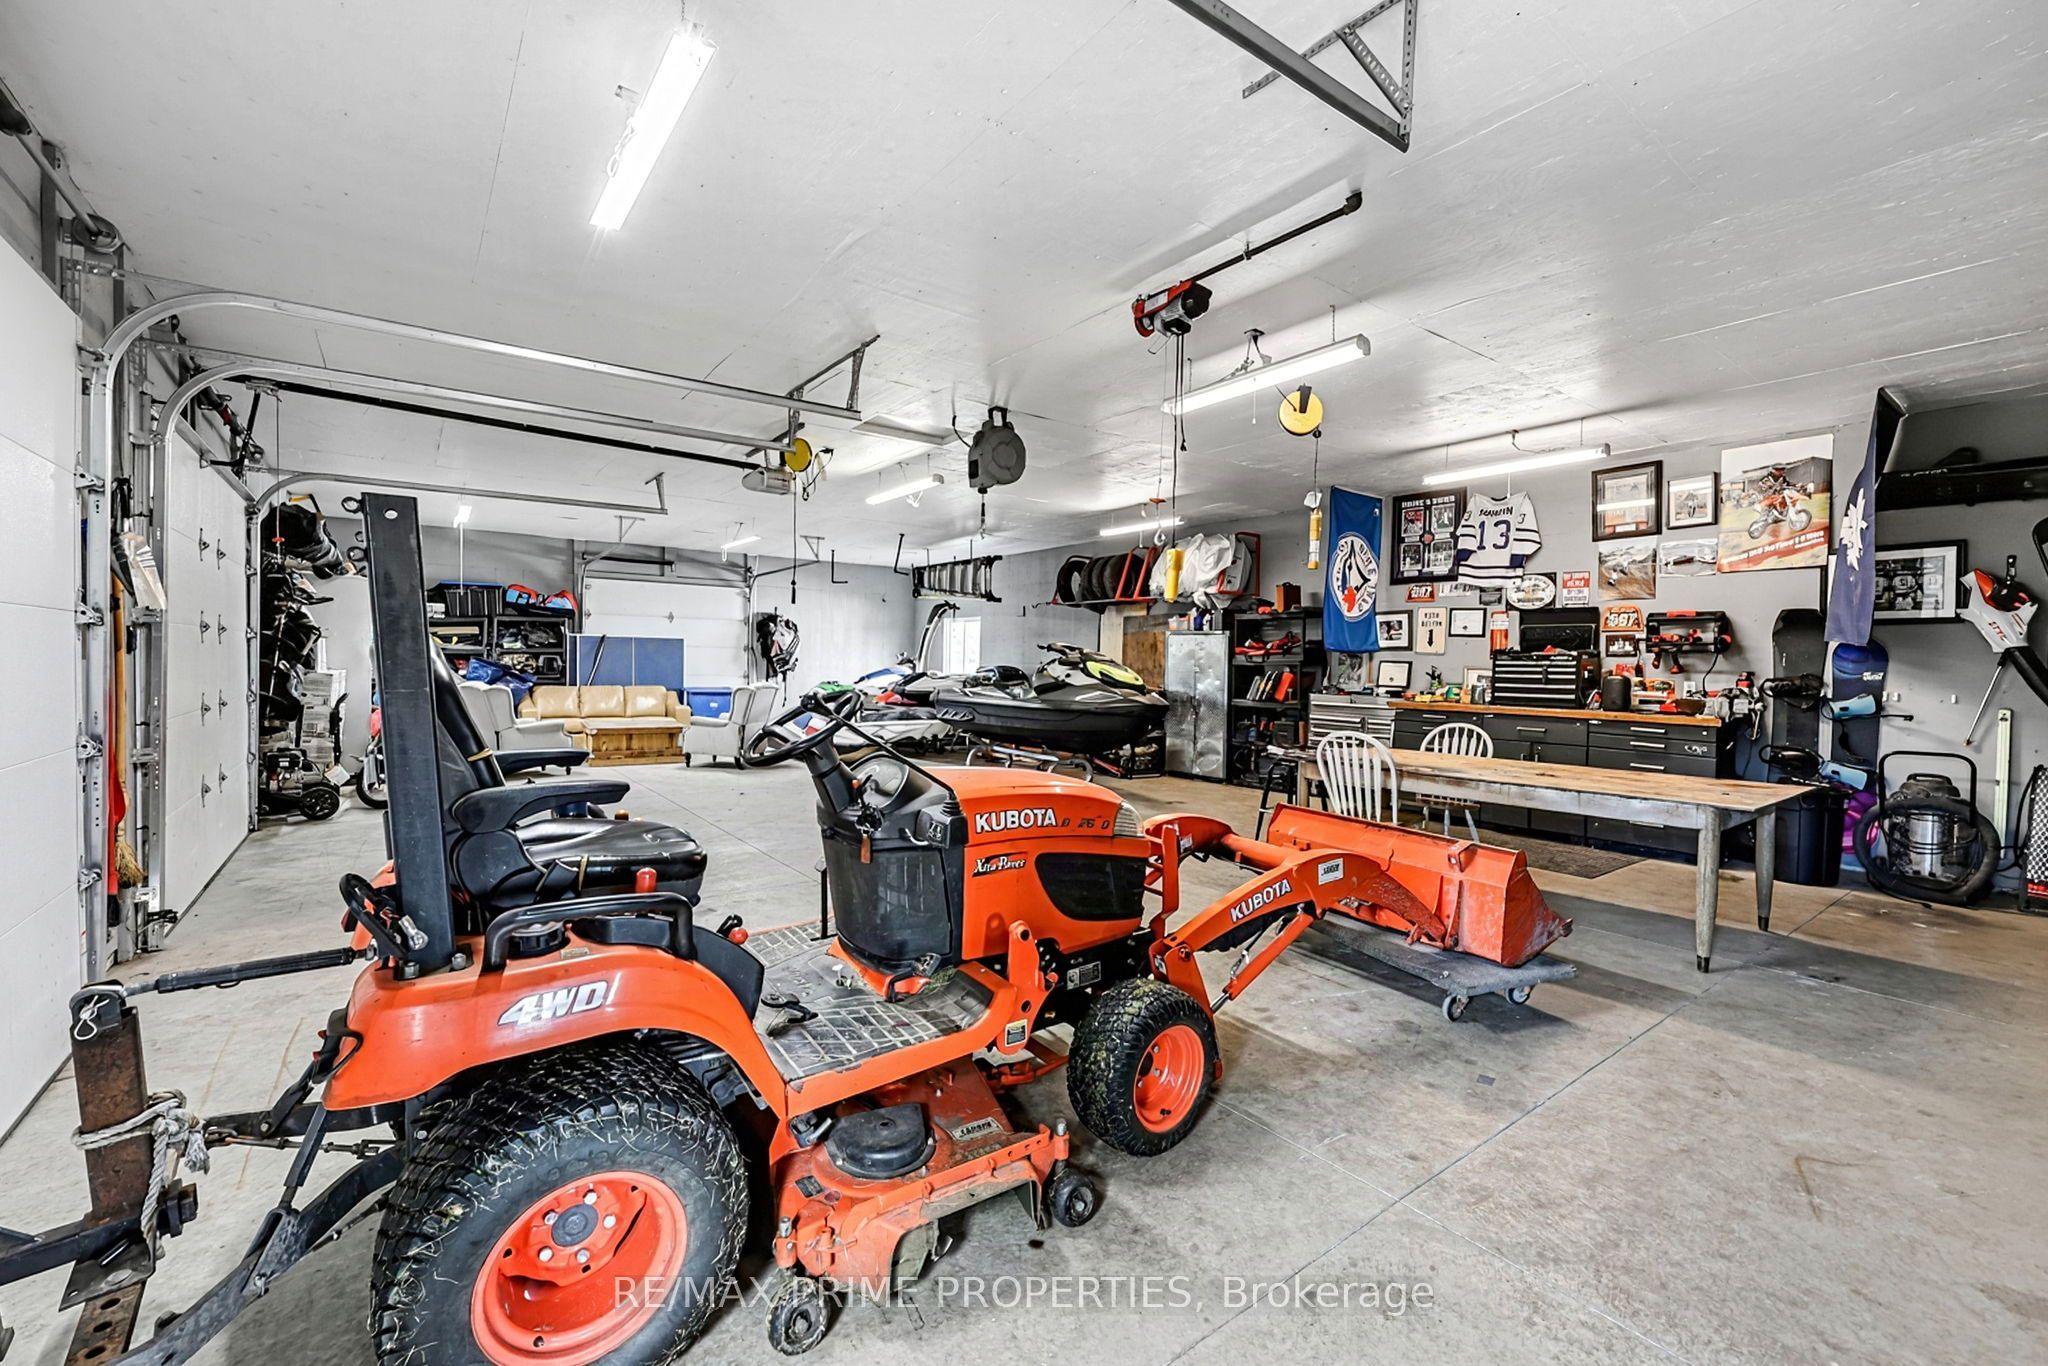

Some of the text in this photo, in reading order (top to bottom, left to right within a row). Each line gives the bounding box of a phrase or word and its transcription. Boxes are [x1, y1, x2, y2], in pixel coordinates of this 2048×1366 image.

[1477, 519, 1511, 550] 13
[975, 808, 1056, 833] KUBOTA
[1229, 879, 1291, 921] KUBOTA
[498, 980, 608, 1025] 4WD
